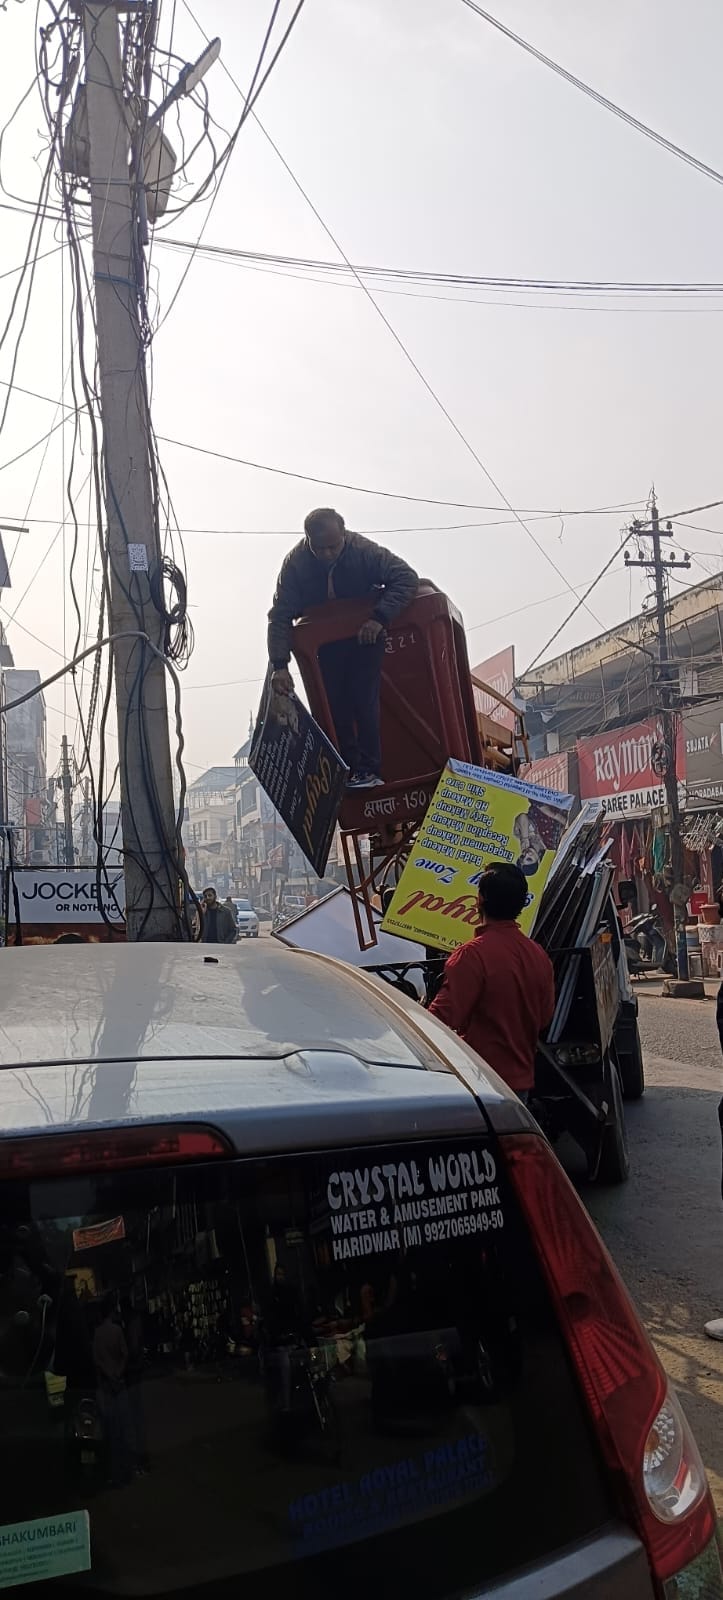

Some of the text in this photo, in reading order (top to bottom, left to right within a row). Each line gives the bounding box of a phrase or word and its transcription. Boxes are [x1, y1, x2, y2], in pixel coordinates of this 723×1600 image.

[686, 736, 709, 753] SUJATA
[445, 778, 465, 791] Care
[465, 782, 486, 797] Skin
[403, 791, 427, 811] 150
[440, 788, 490, 811] HD Makeup
[602, 796, 627, 814] SAREE
[629, 788, 665, 809] PALACE
[435, 800, 494, 827] Party Makeup
[426, 825, 515, 862] Engagement Makeup
[431, 814, 509, 846] Reception Makeup
[420, 838, 483, 866] Bridal Makeup
[415, 858, 458, 885] Zone
[22, 882, 117, 899] JOCKEY
[73, 904, 118, 912] NOTHNG
[397, 890, 482, 926] ayal
[327, 1149, 497, 1210] CRYSTAL WORLD
[331, 1186, 500, 1235] WATER & AMUSEMENT PARK
[332, 1210, 504, 1260] HARIDWAR (M) 9927065949-50
[288, 1483, 353, 1521] HOTEL
[423, 1433, 488, 1473] PALACE
